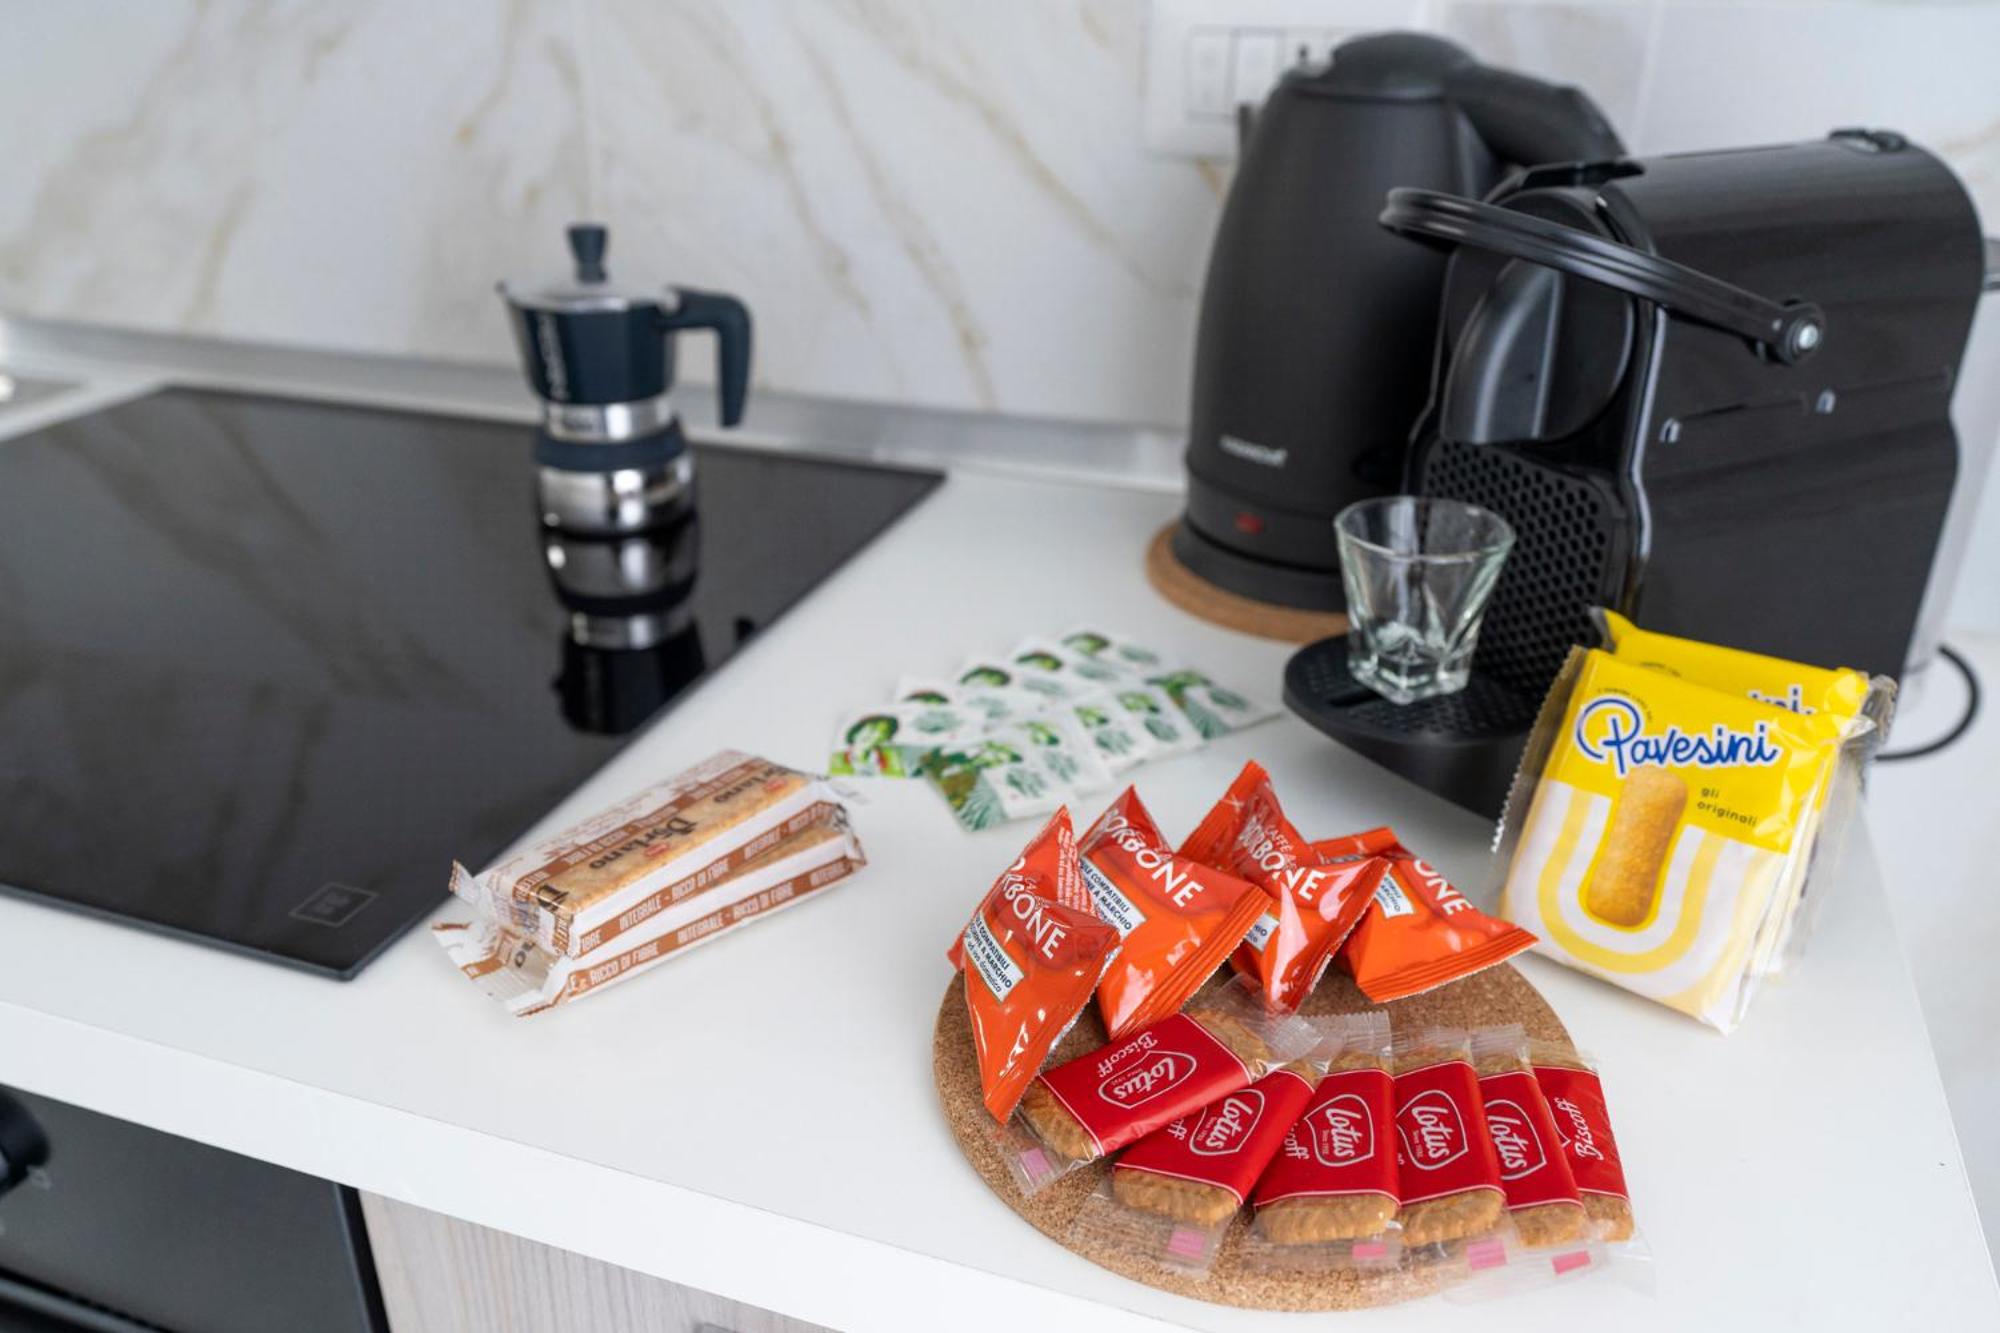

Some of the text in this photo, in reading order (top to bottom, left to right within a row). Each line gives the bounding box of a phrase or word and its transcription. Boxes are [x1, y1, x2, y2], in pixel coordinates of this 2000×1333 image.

[1576, 698, 1779, 775] Pavesini
[1697, 801, 1759, 827] originali
[1700, 786, 1721, 801] gli
[619, 895, 663, 932] INTEGRALE
[1101, 896, 1132, 930] MARCHIO
[985, 953, 1013, 988] MARCHIO
[1098, 1031, 1159, 1078] Biscoff
[1113, 1057, 1175, 1099] Lotus
[1206, 1098, 1254, 1149] Lotus
[1325, 1108, 1363, 1157] Lotus
[1411, 1105, 1454, 1159] Lotus
[1487, 1114, 1529, 1169] Lotus
[1554, 1097, 1605, 1161] Biscoff
